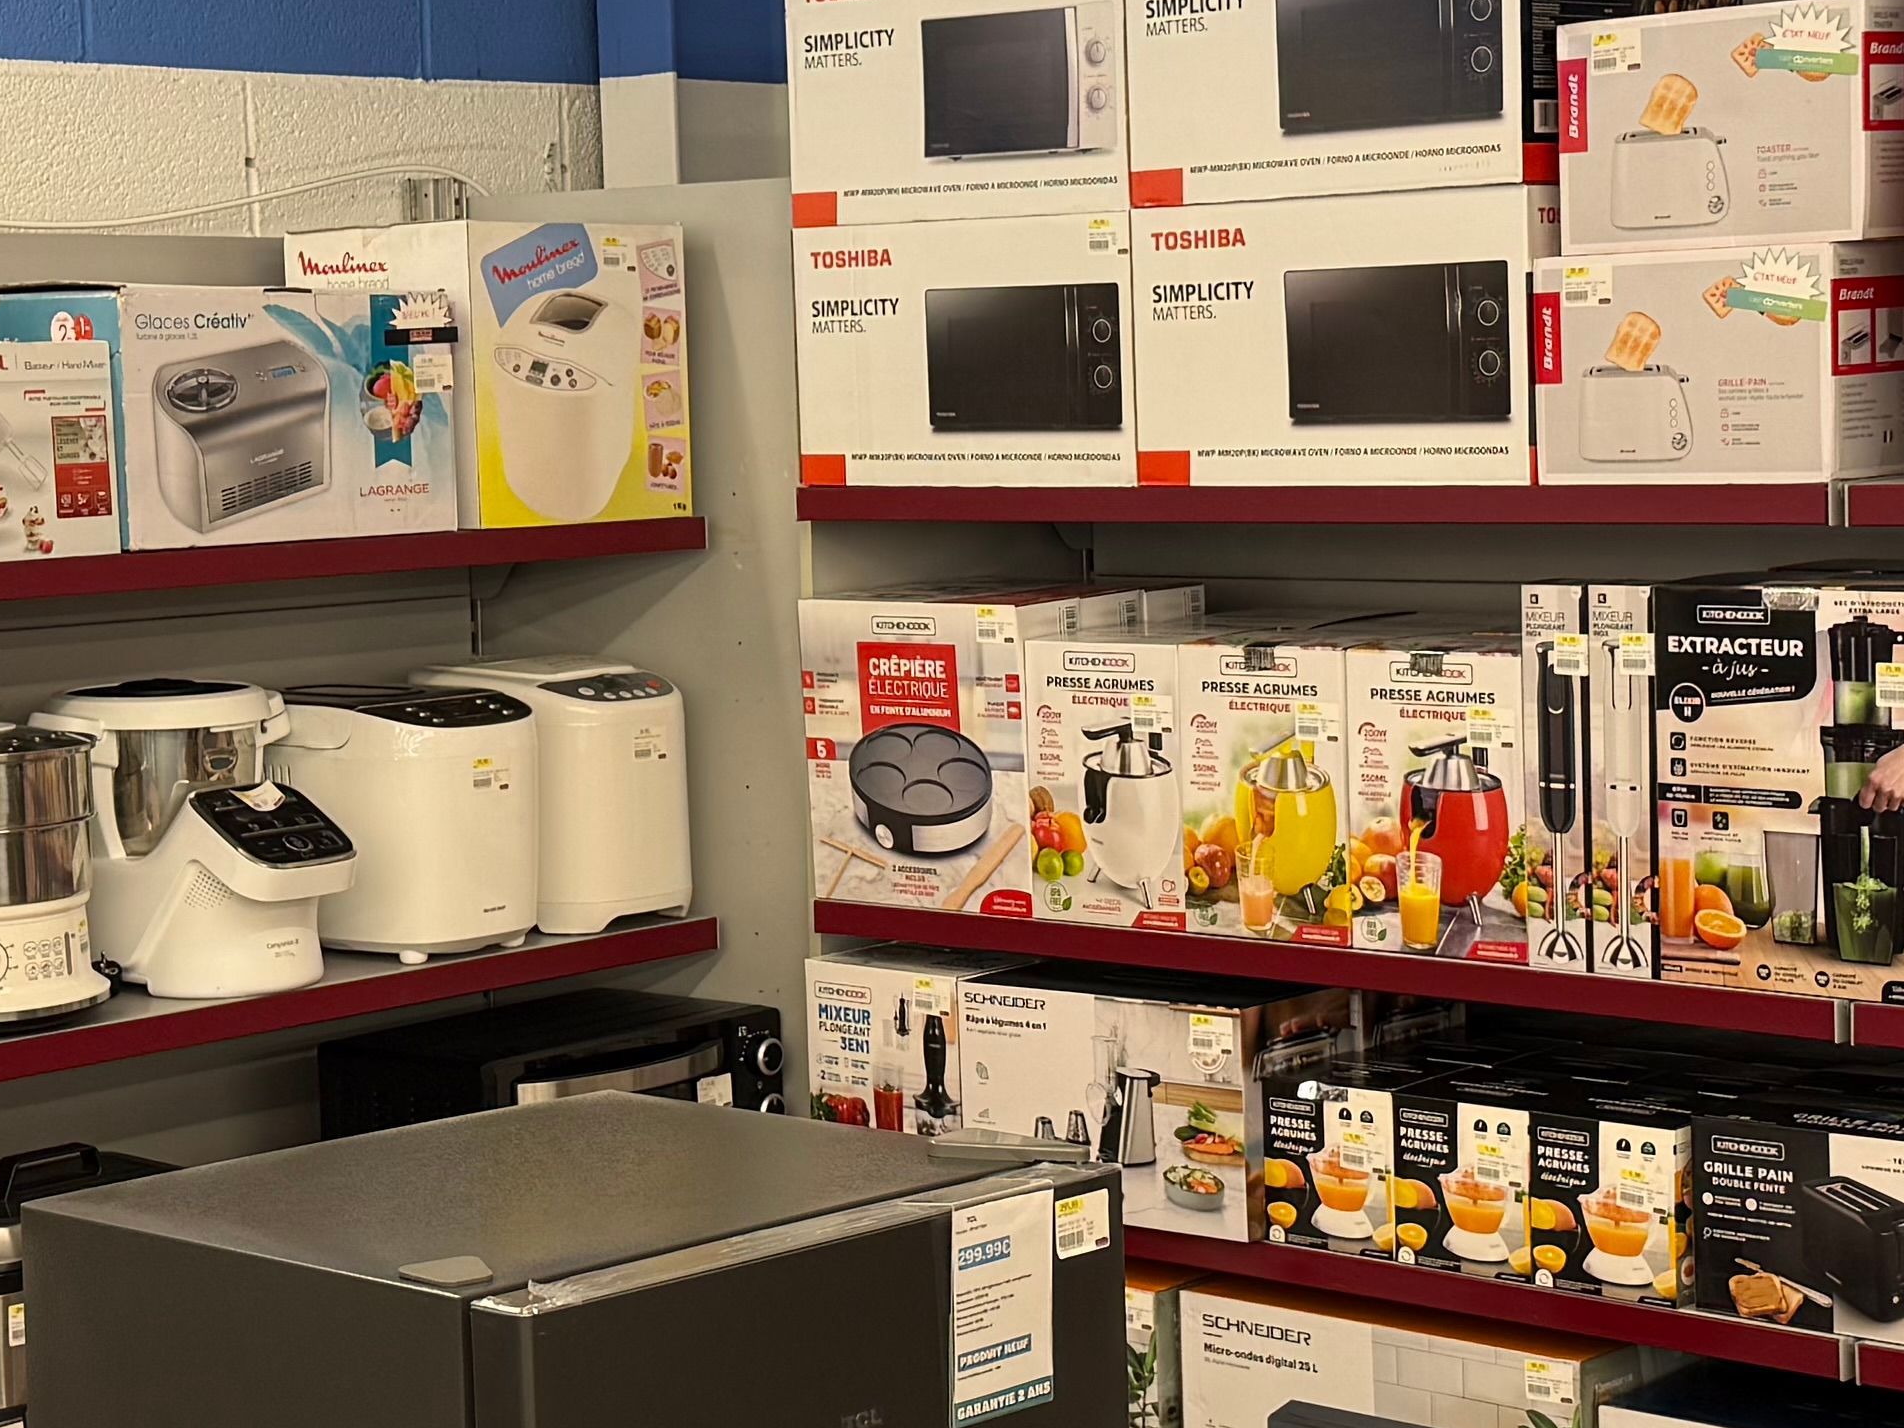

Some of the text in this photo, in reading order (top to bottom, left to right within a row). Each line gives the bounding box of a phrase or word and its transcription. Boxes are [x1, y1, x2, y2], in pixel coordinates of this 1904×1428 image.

[804, 28, 895, 54] SIMPLICITY
[804, 53, 862, 69] MATTERS.
[1568, 74, 1579, 139] Brandt
[1151, 227, 1246, 251] TOSHIBA
[298, 251, 389, 277] Moulinex
[492, 235, 580, 285] Moulinex
[811, 249, 892, 270] TOSHIBA
[1153, 281, 1254, 304] SIMPLICITY
[811, 298, 899, 317] SIMPLICITY
[135, 312, 188, 330] Glaces
[812, 319, 866, 334] MATTERS.
[1544, 306, 1553, 370] Brandt
[360, 483, 429, 498] LAGRANGE
[1667, 636, 1803, 657] EXTRACTEUR
[869, 655, 945, 678] CRÊPIÈRE
[1713, 659, 1758, 680] à jus
[869, 678, 948, 699] ÉLECTRIQUE
[1046, 677, 1155, 692] PRESSE AGRUMES
[1370, 688, 1495, 704] PRESSE AGRUMES
[1399, 707, 1467, 721] ÉLECTRIQUE
[964, 992, 1045, 1010] SCHNEIDER
[818, 1003, 871, 1024] MIXEUR
[819, 1021, 870, 1037] PLONGEANT
[840, 1036, 871, 1053] 3EN1
[1704, 1161, 1793, 1184] GRILLE PAIN
[1202, 1314, 1311, 1346] SCHNEIDER
